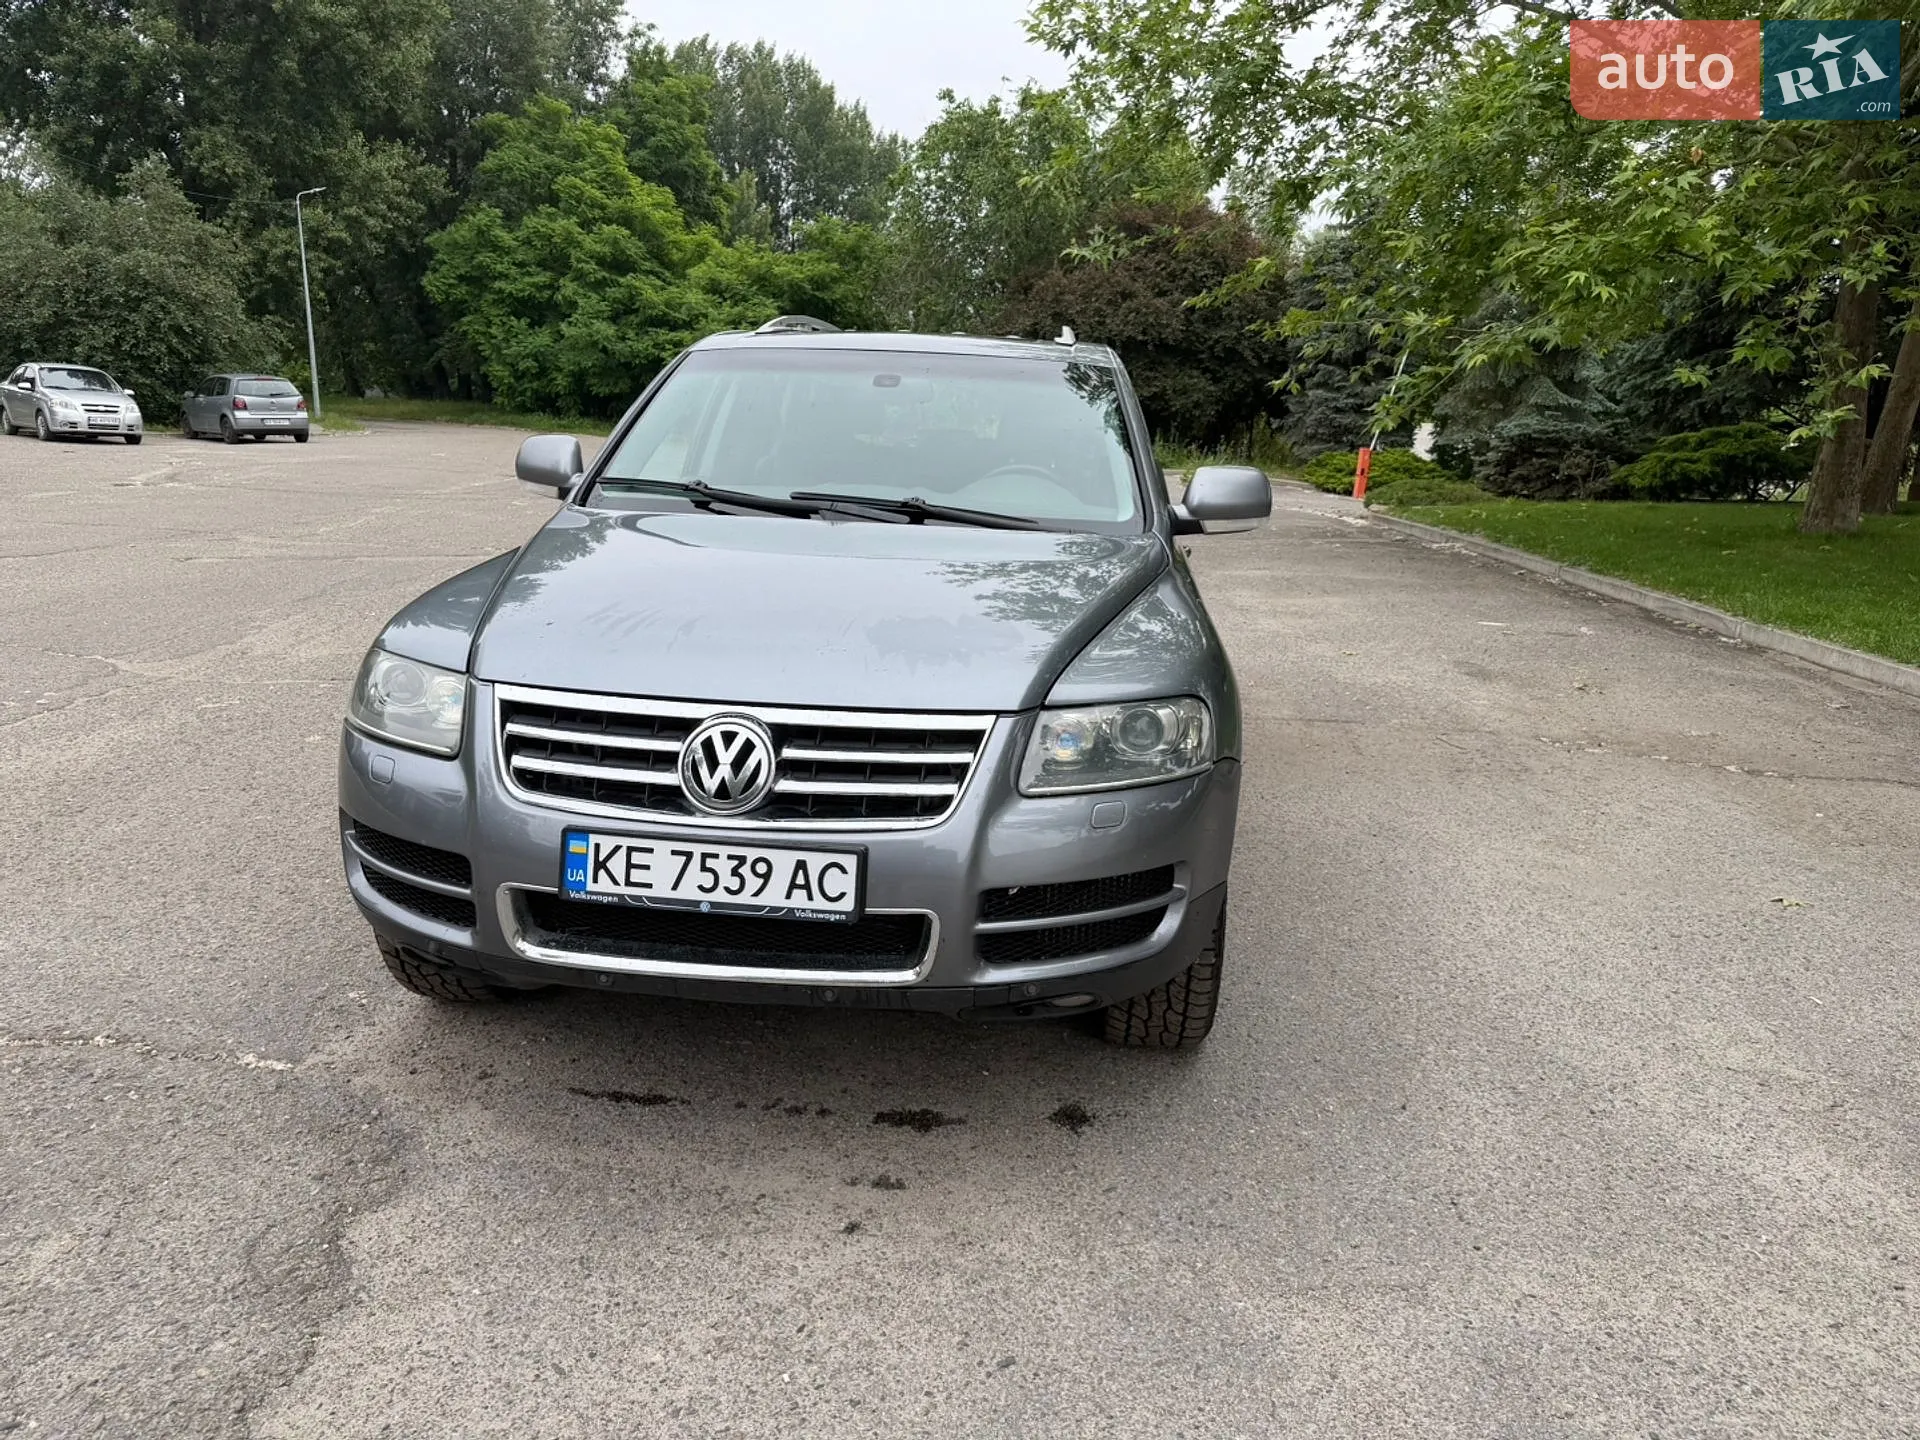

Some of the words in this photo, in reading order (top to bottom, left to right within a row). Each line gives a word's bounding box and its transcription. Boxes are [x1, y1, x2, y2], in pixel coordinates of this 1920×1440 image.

[690, 729, 764, 800] VW
[567, 868, 585, 882] UA
[592, 842, 655, 889] KE
[670, 849, 774, 898] 7539
[785, 858, 849, 903] AC
[569, 890, 618, 903] Volkswagen
[794, 908, 846, 920] Volkswagen
